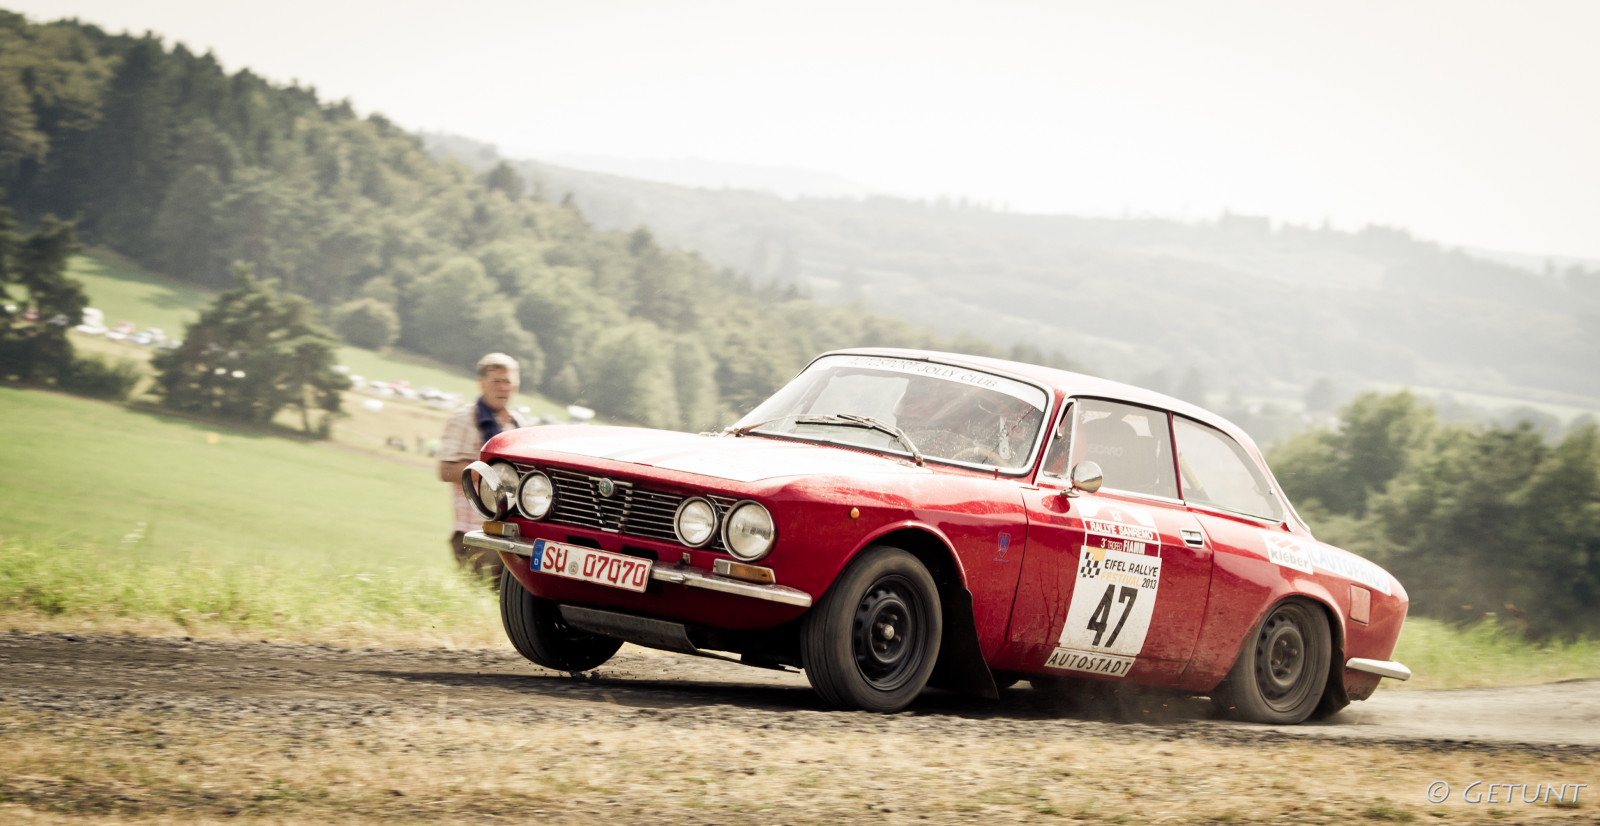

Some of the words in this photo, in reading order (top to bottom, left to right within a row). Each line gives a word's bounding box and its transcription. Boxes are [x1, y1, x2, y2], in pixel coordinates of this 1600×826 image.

[918, 364, 956, 377] JOLLY
[960, 373, 998, 387] CLUB
[1090, 522, 1117, 536] RALLYE
[1119, 526, 1153, 541] SANREMO
[1123, 540, 1145, 555] FIAMM
[543, 546, 568, 572] SU
[583, 554, 646, 586] 07070
[1104, 558, 1126, 572] EIFEL
[1128, 562, 1158, 577] RALLYE
[1101, 571, 1140, 588] FESTIVAL
[1141, 578, 1157, 590] 2013
[1087, 584, 1138, 647] 47
[1048, 653, 1133, 675] AUTOSTADT
